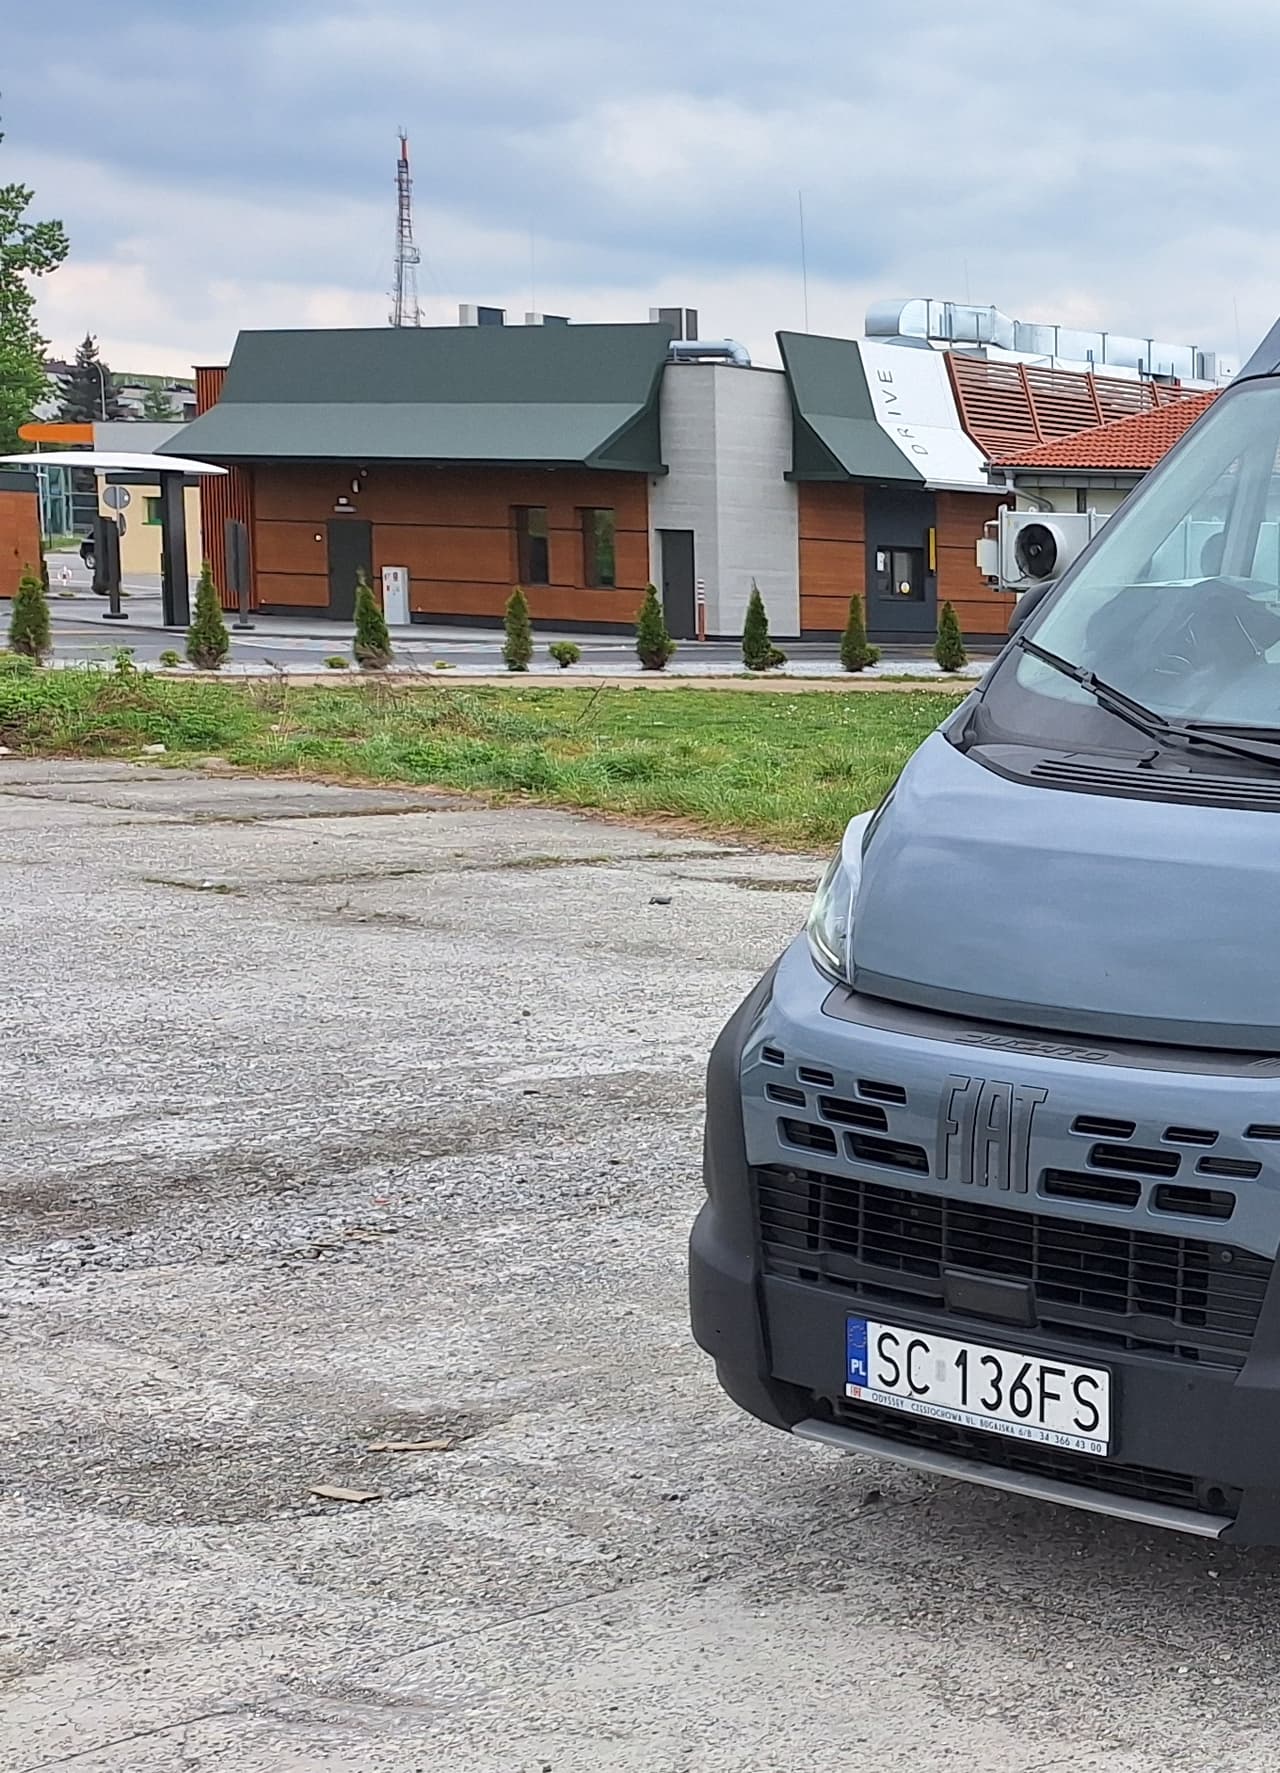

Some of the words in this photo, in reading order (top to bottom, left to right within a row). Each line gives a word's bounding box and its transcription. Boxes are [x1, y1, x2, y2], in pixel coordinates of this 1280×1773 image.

[877, 369, 928, 455] DRIVE
[935, 1073, 1048, 1193] FIAT
[851, 1358, 867, 1377] PL
[877, 1332, 931, 1395] SC
[954, 1349, 1100, 1432] 136FS
[871, 1392, 904, 1408] ODYSSEY
[1039, 1431, 1050, 1441] 34
[1055, 1434, 1071, 1447] 366
[1075, 1439, 1086, 1450] 43
[1090, 1442, 1102, 1454] 00
